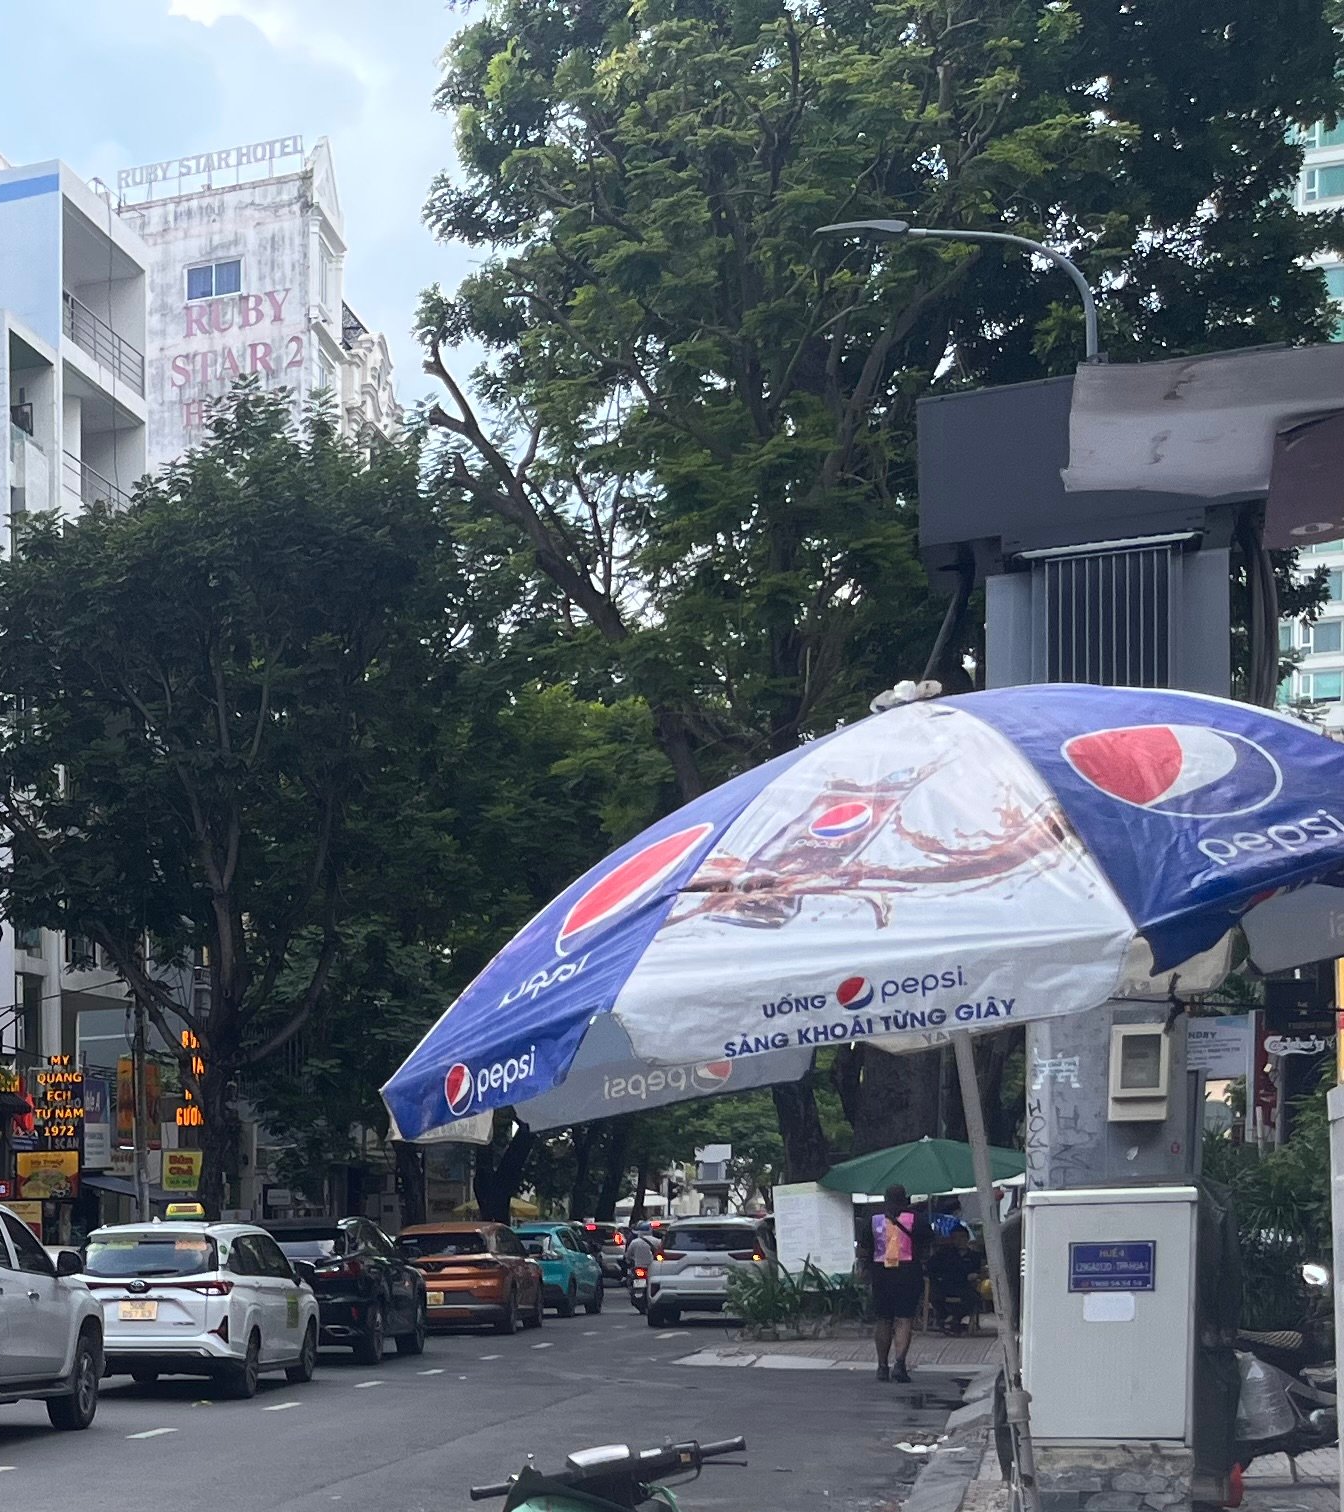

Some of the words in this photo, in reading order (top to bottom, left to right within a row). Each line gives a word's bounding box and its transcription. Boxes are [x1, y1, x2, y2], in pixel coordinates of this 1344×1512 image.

[117, 160, 172, 190] RUBY
[178, 150, 231, 178] STAR
[236, 134, 304, 166] HOTEL
[183, 289, 292, 338] RUBY
[170, 341, 275, 389] STAR
[286, 335, 305, 369] 2
[1198, 807, 1344, 866] pepsi
[762, 992, 827, 1019] UỐNG
[881, 965, 968, 1003] pepsi
[724, 1031, 790, 1058] SẢNG
[797, 1013, 874, 1046] KHOÁI
[880, 1007, 948, 1032] TỪNG
[955, 997, 1016, 1022] GIÂY
[477, 1044, 537, 1102] pepsi
[43, 1125, 75, 1137] 1972
